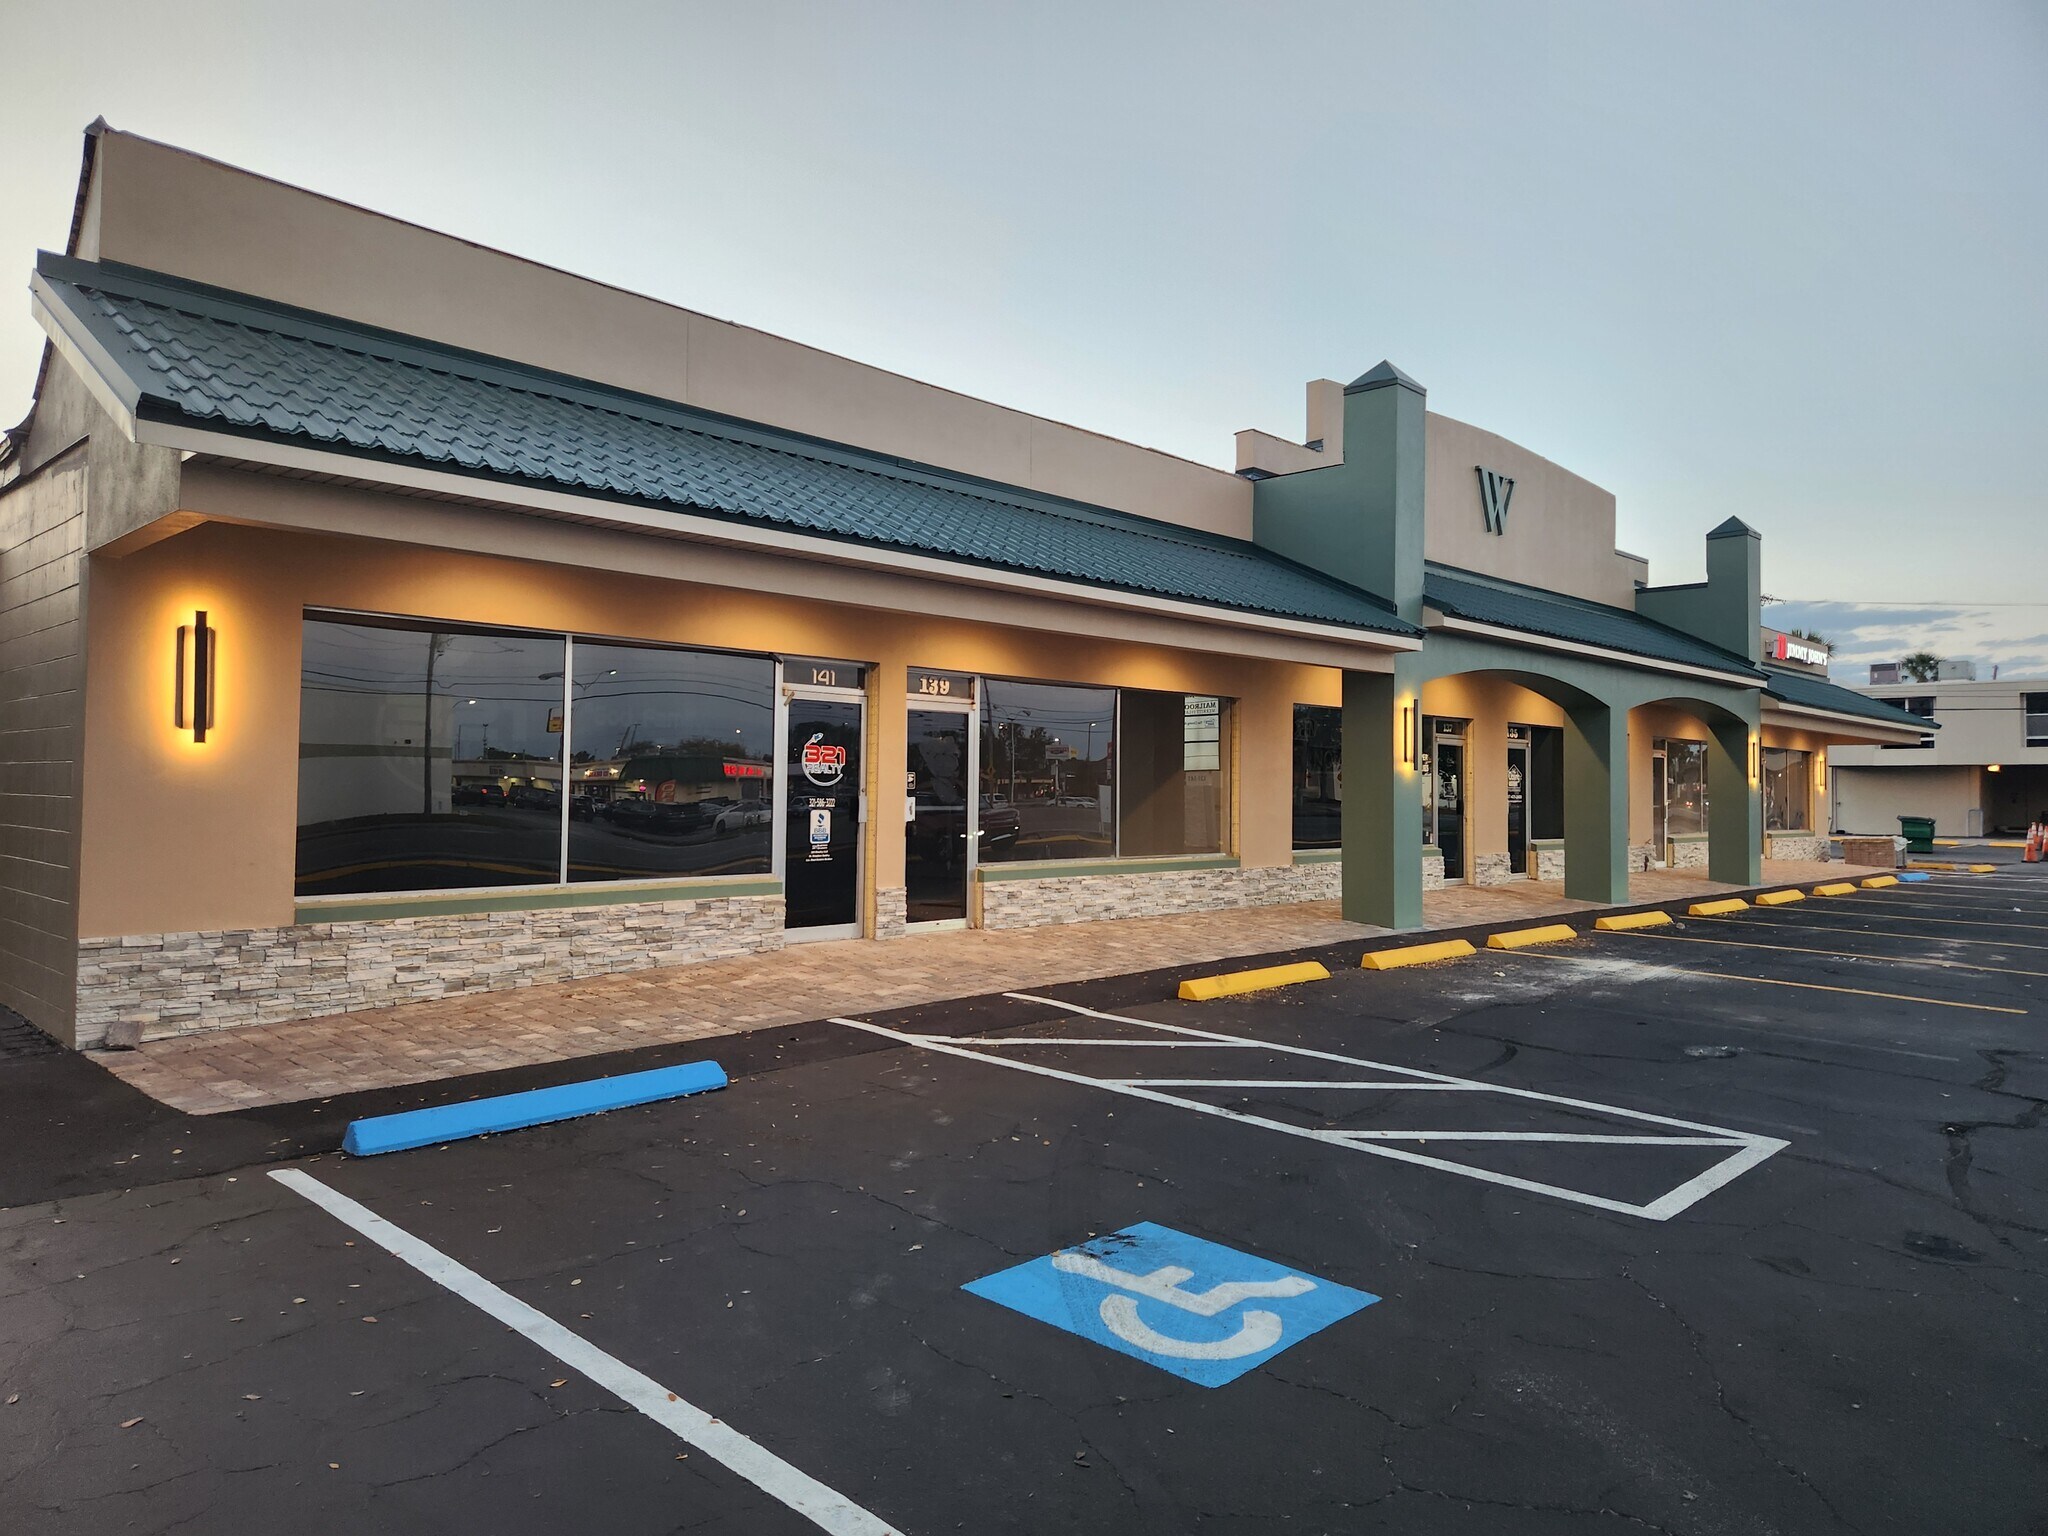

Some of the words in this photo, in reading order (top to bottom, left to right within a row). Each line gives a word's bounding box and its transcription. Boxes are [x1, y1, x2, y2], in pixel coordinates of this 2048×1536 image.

[1474, 465, 1517, 536] W
[1787, 643, 1807, 660] JIMMY
[1808, 649, 1828, 666] JOHN'S
[812, 667, 836, 686] 141
[919, 676, 950, 696] 139
[804, 744, 846, 766] 321
[805, 764, 845, 775] REALTY
